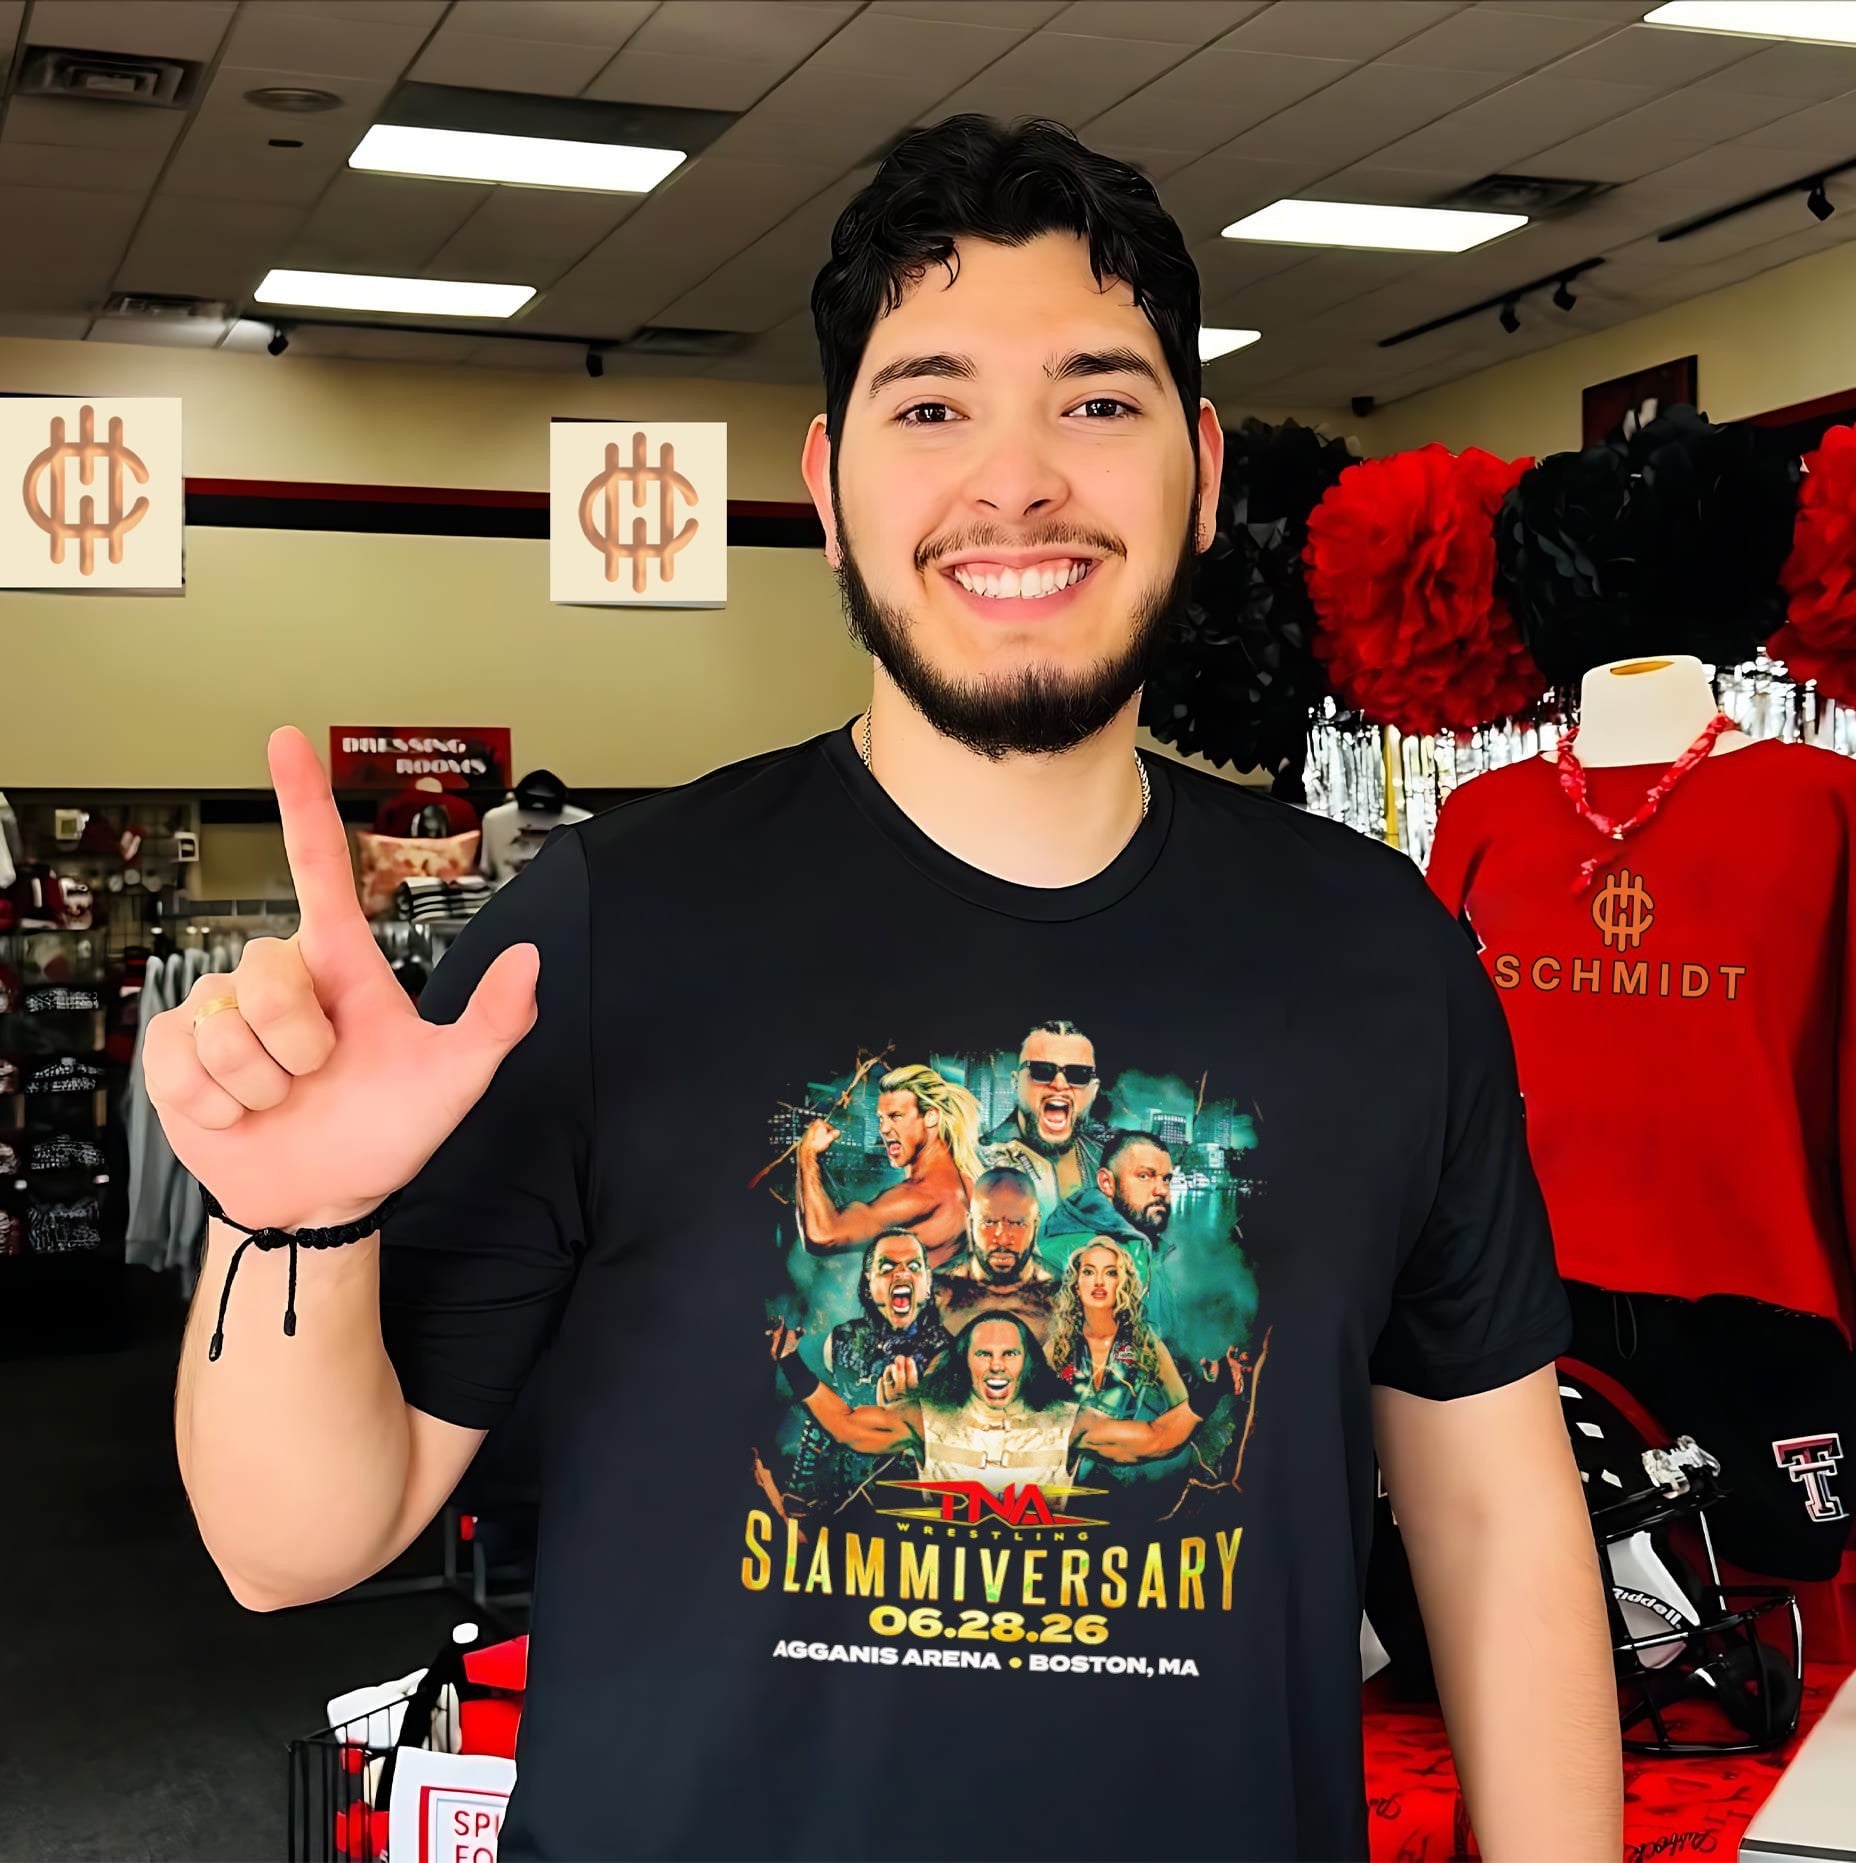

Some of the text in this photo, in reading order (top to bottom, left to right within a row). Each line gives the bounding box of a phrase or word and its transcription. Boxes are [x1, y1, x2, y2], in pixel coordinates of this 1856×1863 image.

[396, 758, 487, 775] ROOMS
[1494, 954, 1747, 1001] SCHMIDT
[897, 1480, 1056, 1526] TNA
[896, 1521, 1089, 1542] WRESTLING
[740, 1509, 1244, 1612] SLAMMIVERSARY
[868, 1605, 1110, 1645] 06.28.26
[773, 1639, 1200, 1679] AGGANIS ARENA BOSTON, MA
[454, 1809, 500, 1838] SPI
